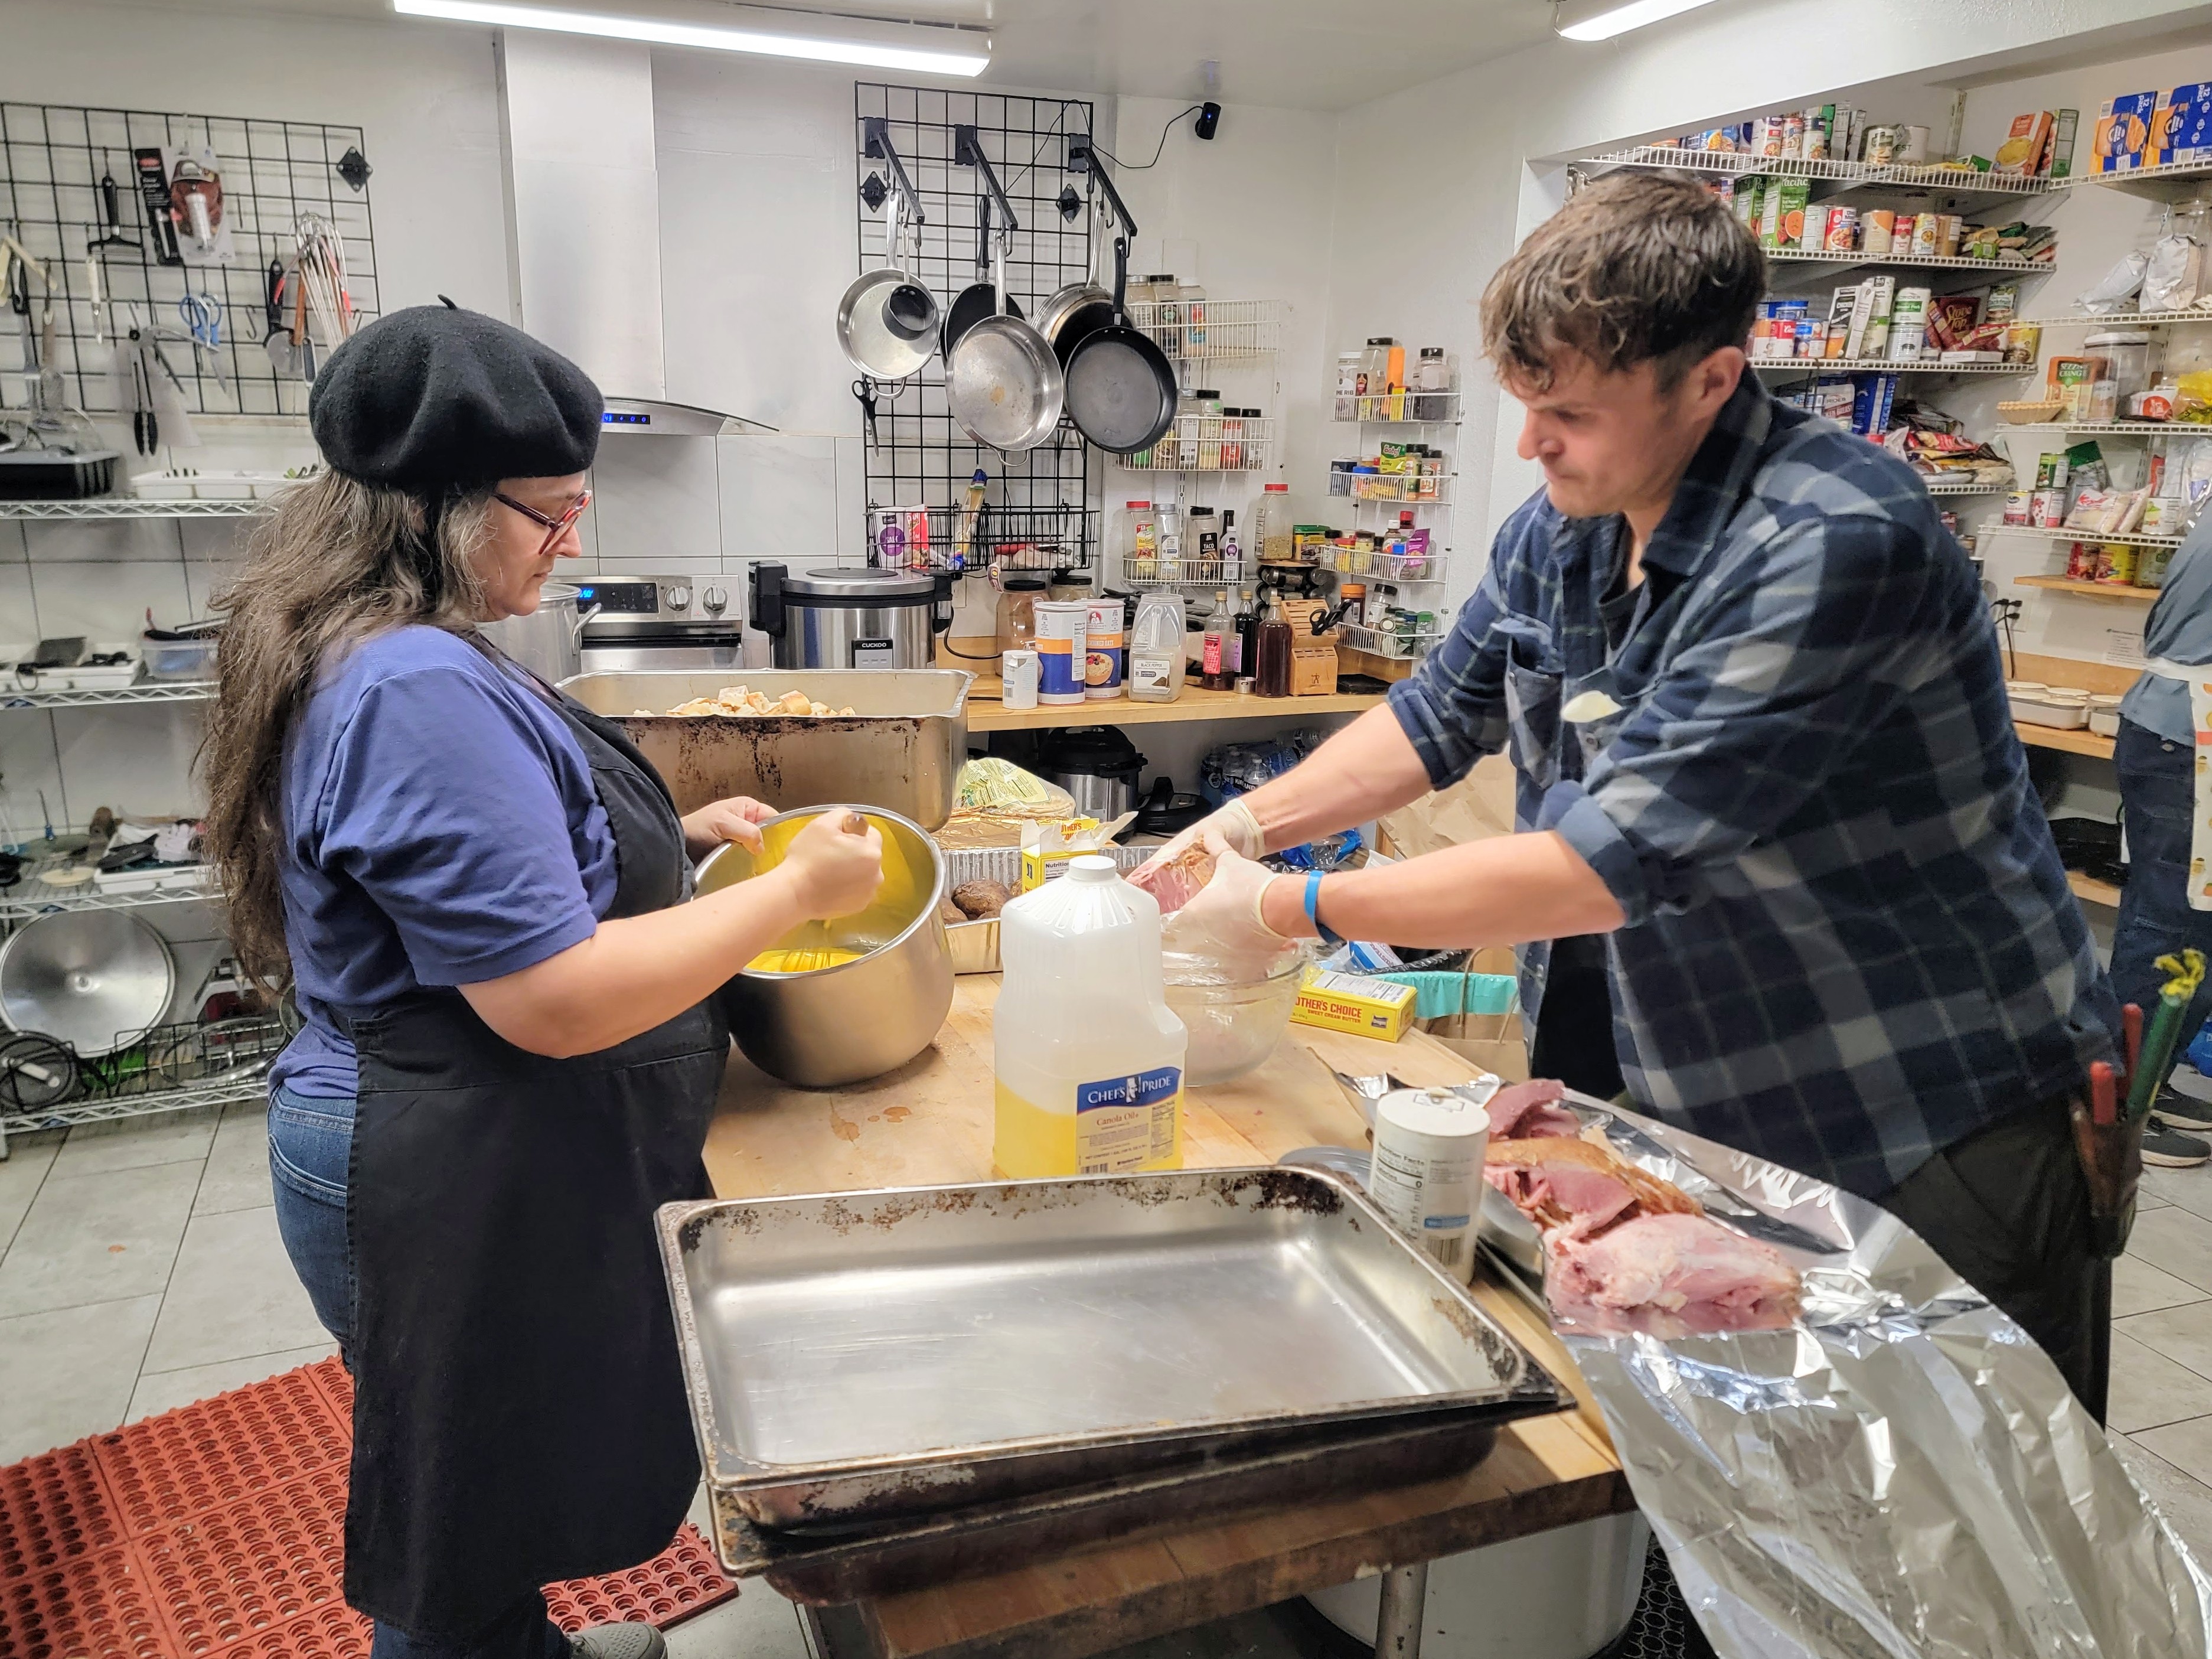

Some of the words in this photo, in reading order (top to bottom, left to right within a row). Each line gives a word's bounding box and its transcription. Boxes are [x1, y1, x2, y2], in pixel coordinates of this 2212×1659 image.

[2143, 98, 2150, 107] 12
[1782, 176, 1809, 187] Pacific
[1061, 823, 1082, 833] OTHER'S
[1295, 996, 1328, 1011] OTHER'S
[1330, 1003, 1363, 1018] CHOICE
[1324, 1012, 1341, 1020] CREAM
[1342, 1016, 1361, 1024] BUTTER
[1088, 1086, 1125, 1104] CHEF'S
[1142, 1075, 1172, 1093] PRIDE
[1097, 1114, 1123, 1126] Canola
[1124, 1112, 1135, 1121] Oil
